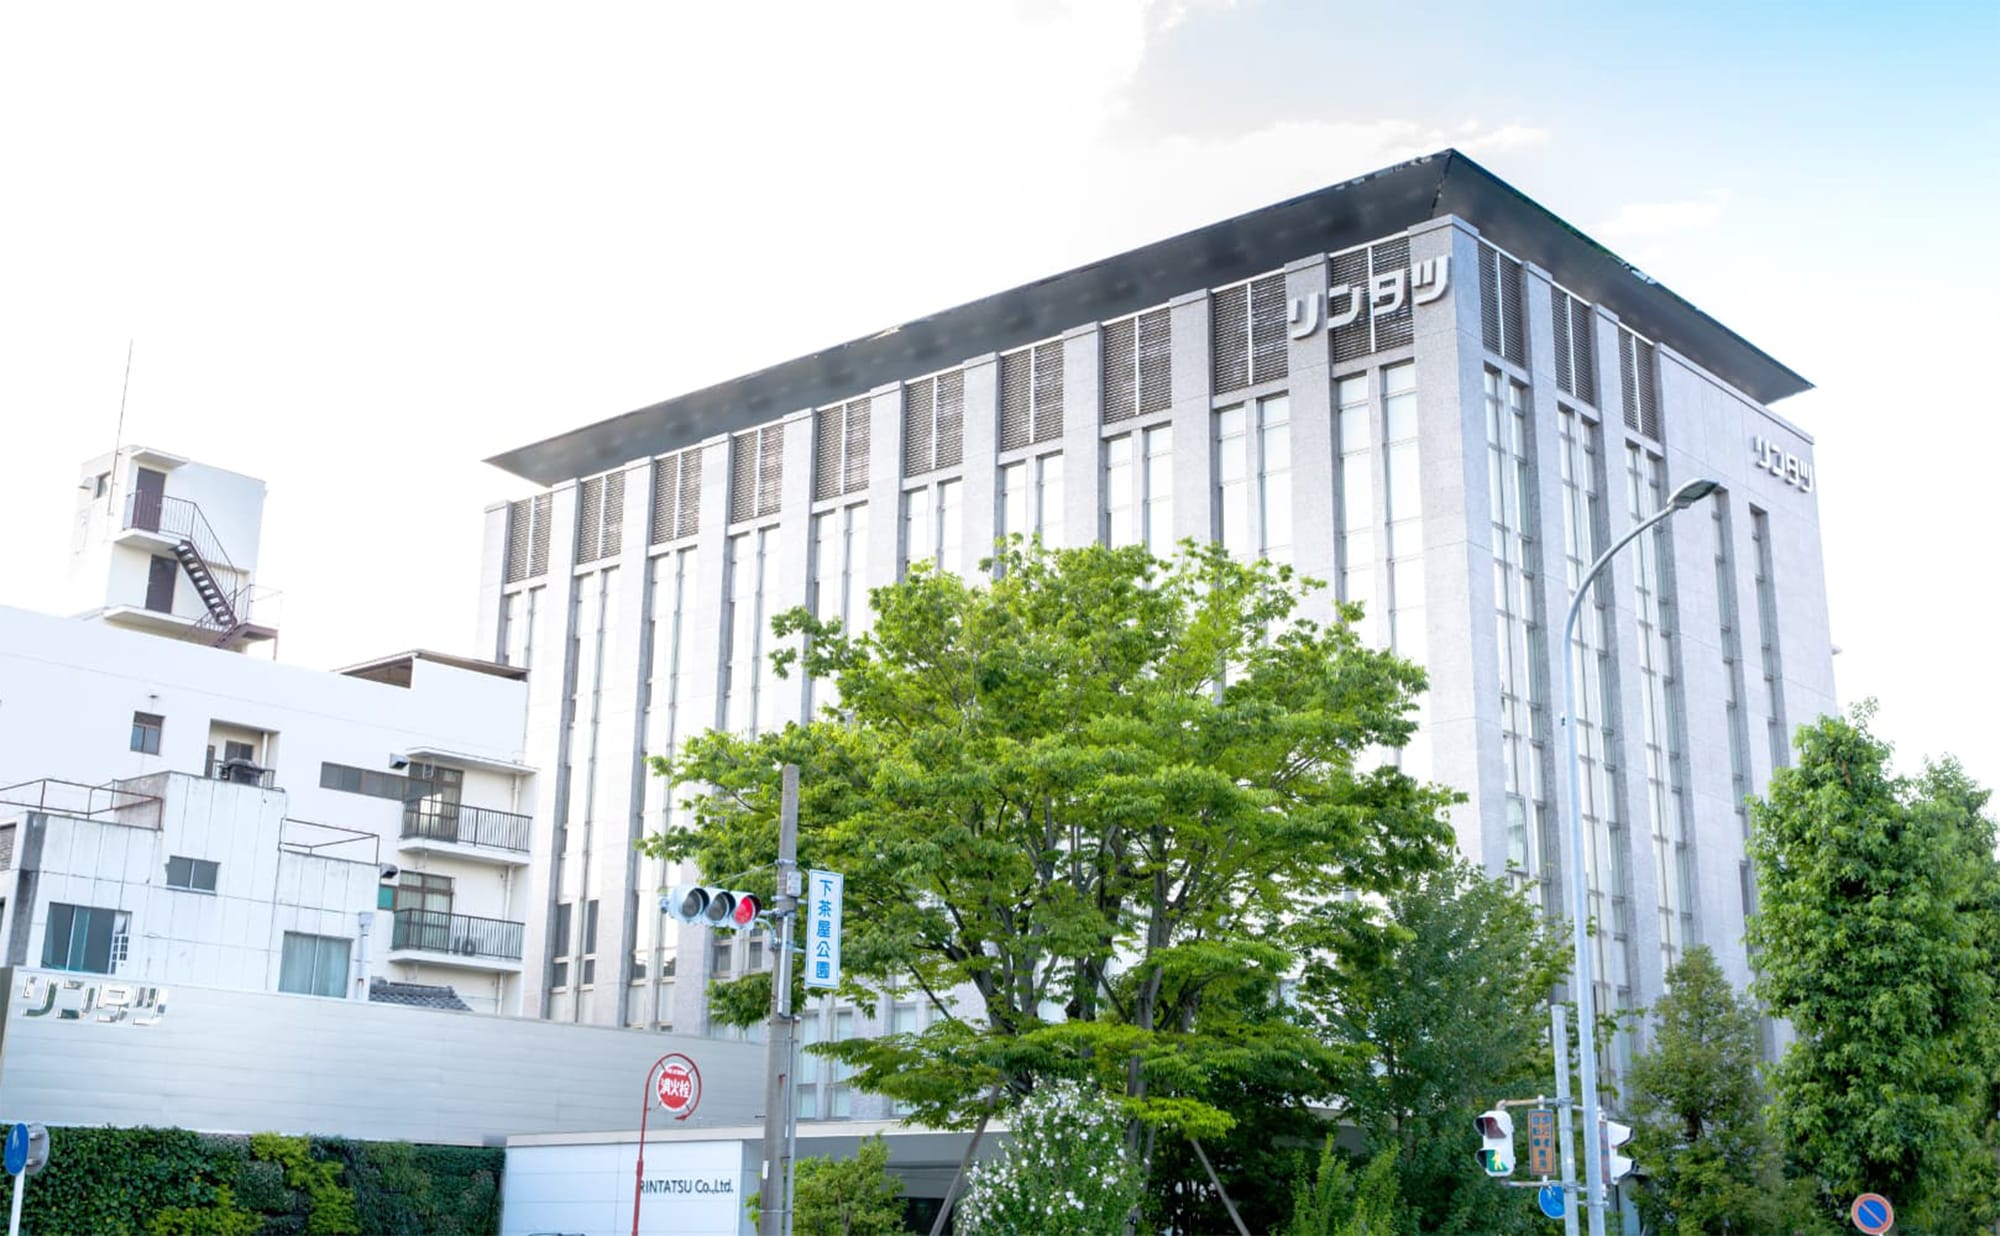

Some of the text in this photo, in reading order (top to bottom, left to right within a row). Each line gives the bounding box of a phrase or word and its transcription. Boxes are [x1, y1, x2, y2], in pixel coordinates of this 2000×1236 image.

[1287, 254, 1450, 340] リンタツ
[1752, 434, 1813, 493] リンタツ
[816, 879, 833, 979] 下茶屋公園
[22, 976, 168, 1026] リンタツ
[660, 1078, 690, 1098] 消火栓
[695, 1179, 734, 1195] Co.,Ltd.
